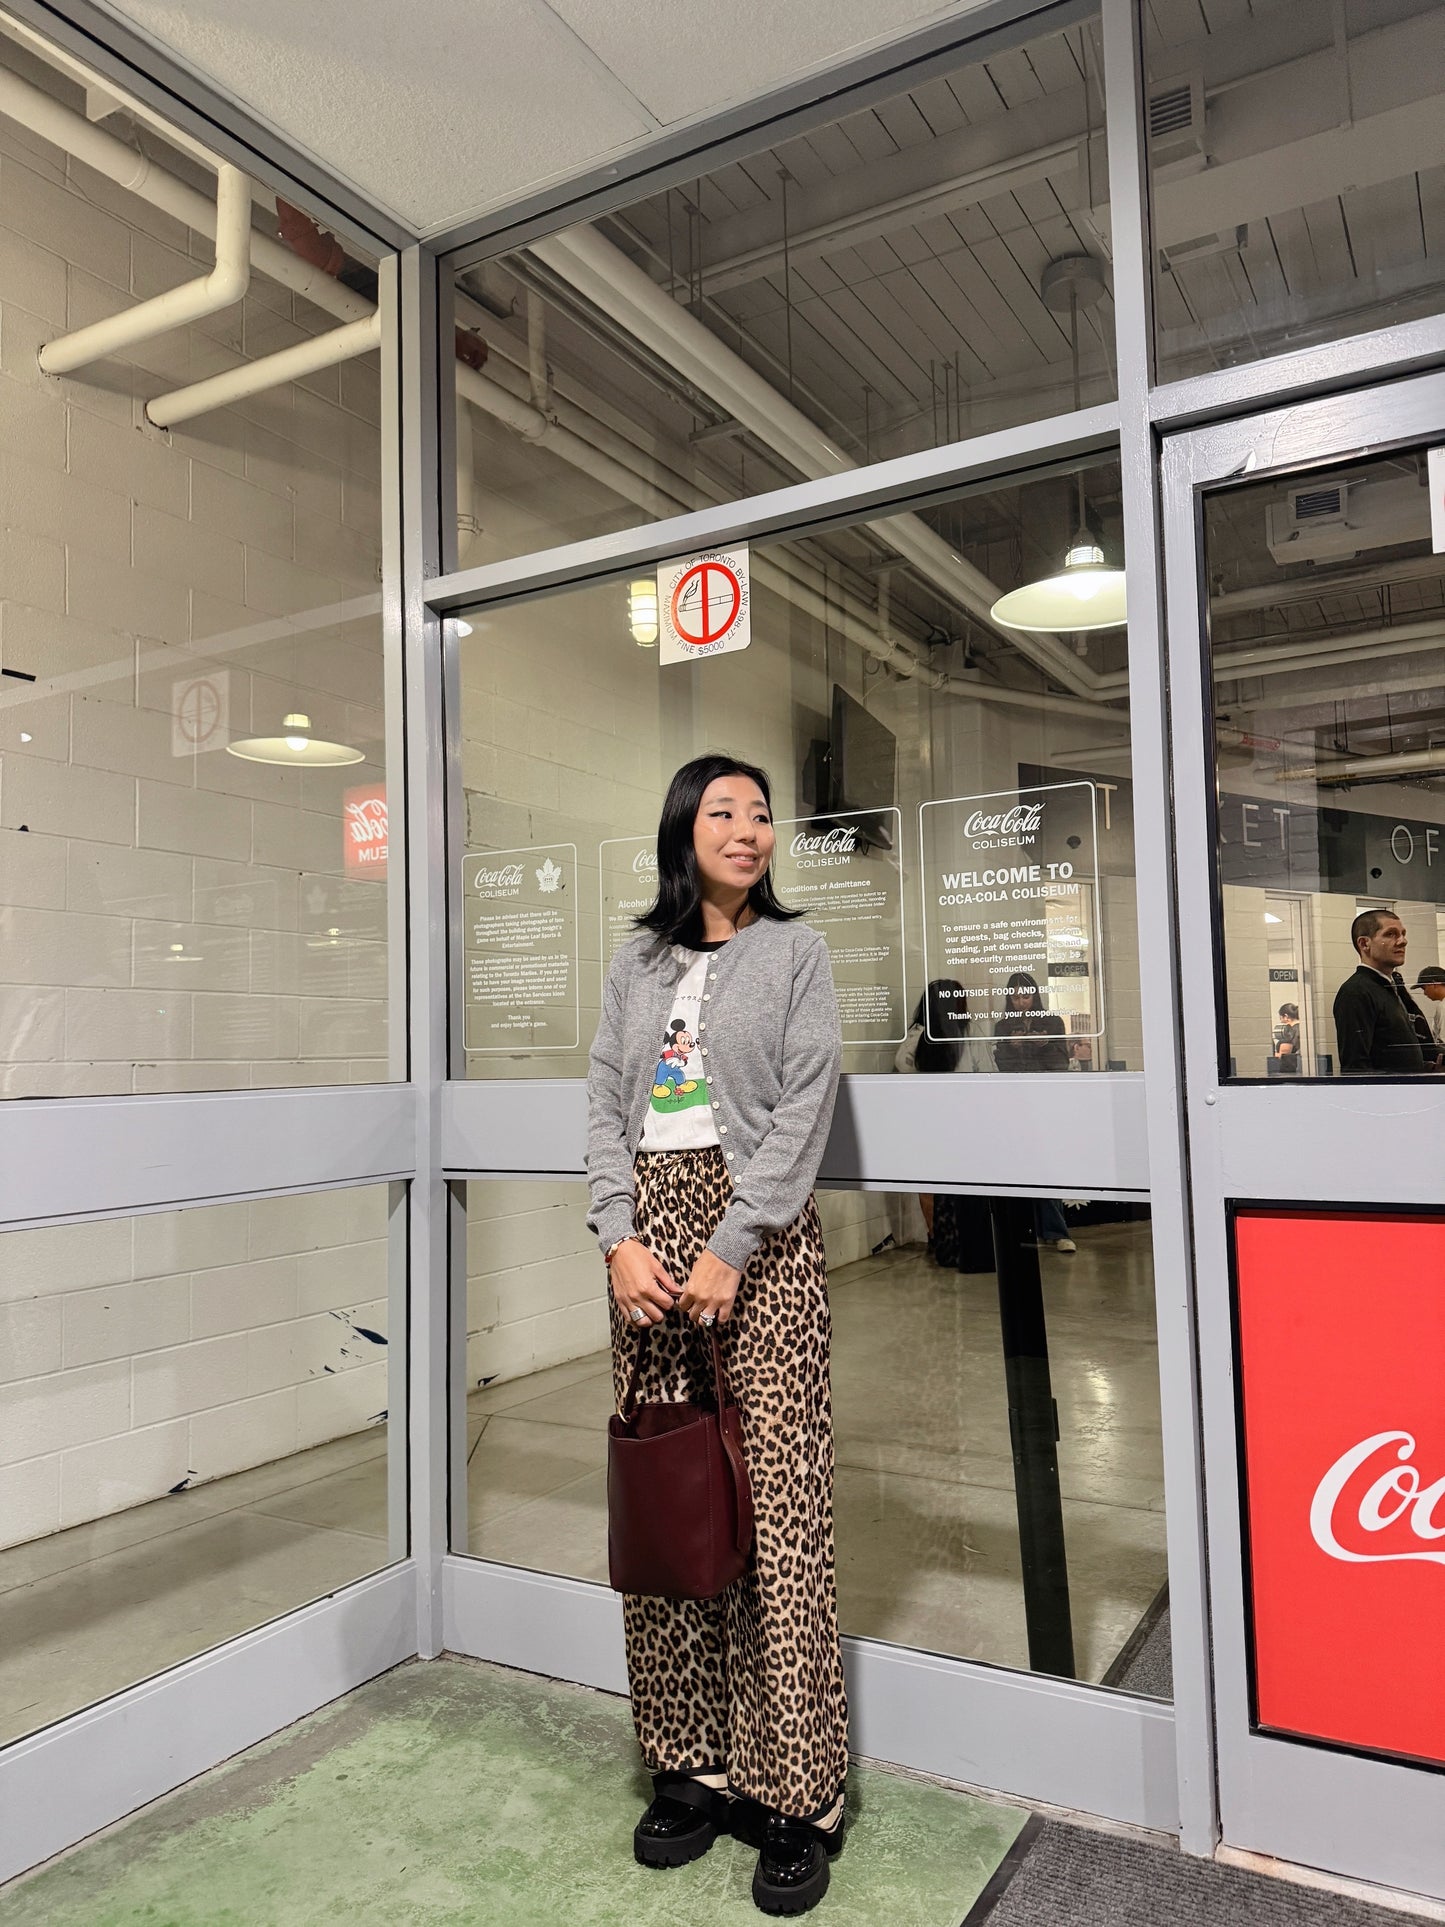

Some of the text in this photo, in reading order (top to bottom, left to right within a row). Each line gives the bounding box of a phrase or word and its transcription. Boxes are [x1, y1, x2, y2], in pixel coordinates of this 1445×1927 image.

[669, 570, 684, 589] CITY
[685, 558, 696, 570] OF
[699, 554, 736, 568] TORONTO
[735, 569, 748, 606] BY-LAW
[664, 595, 678, 640] MAXIMUM
[677, 640, 695, 653] FINE
[963, 802, 1046, 838] Coca-Cola
[789, 826, 860, 858] Coca-Cola
[972, 834, 1035, 851] COLISEUM
[796, 856, 850, 869] COLISEUM
[474, 863, 526, 889] Coca-Cola
[942, 862, 1073, 890] WELCOME TO
[479, 888, 519, 898] COLISEUM
[781, 880, 871, 894] Conditions of Admittance
[938, 883, 1079, 906] COCA-COLA COLISEUM
[618, 898, 648, 909] Alcohol
[942, 925, 951, 933] To
[954, 924, 980, 932] ensure
[991, 921, 1008, 929] safe
[1011, 915, 1064, 928] environment
[1066, 914, 1078, 922] for
[946, 936, 959, 944] our
[961, 934, 991, 943] guests,
[993, 932, 1009, 941] bag
[1011, 930, 1045, 939] checks,
[945, 945, 981, 954] wanding,
[983, 944, 997, 952] pat
[999, 942, 1021, 951] down
[947, 957, 968, 965] other
[970, 955, 1003, 964] security
[1005, 953, 1047, 961] measures
[1069, 949, 1080, 958] be
[989, 963, 1036, 974] conducted.
[1273, 970, 1294, 981] OPEN
[938, 990, 951, 999] NO
[953, 988, 989, 998] OUTSIDE
[992, 987, 1015, 996] FOOD
[1017, 986, 1036, 995] AND
[947, 1012, 972, 1020] Thank
[974, 1012, 989, 1021] you
[991, 1011, 1002, 1019] for
[1005, 1011, 1022, 1019] your
